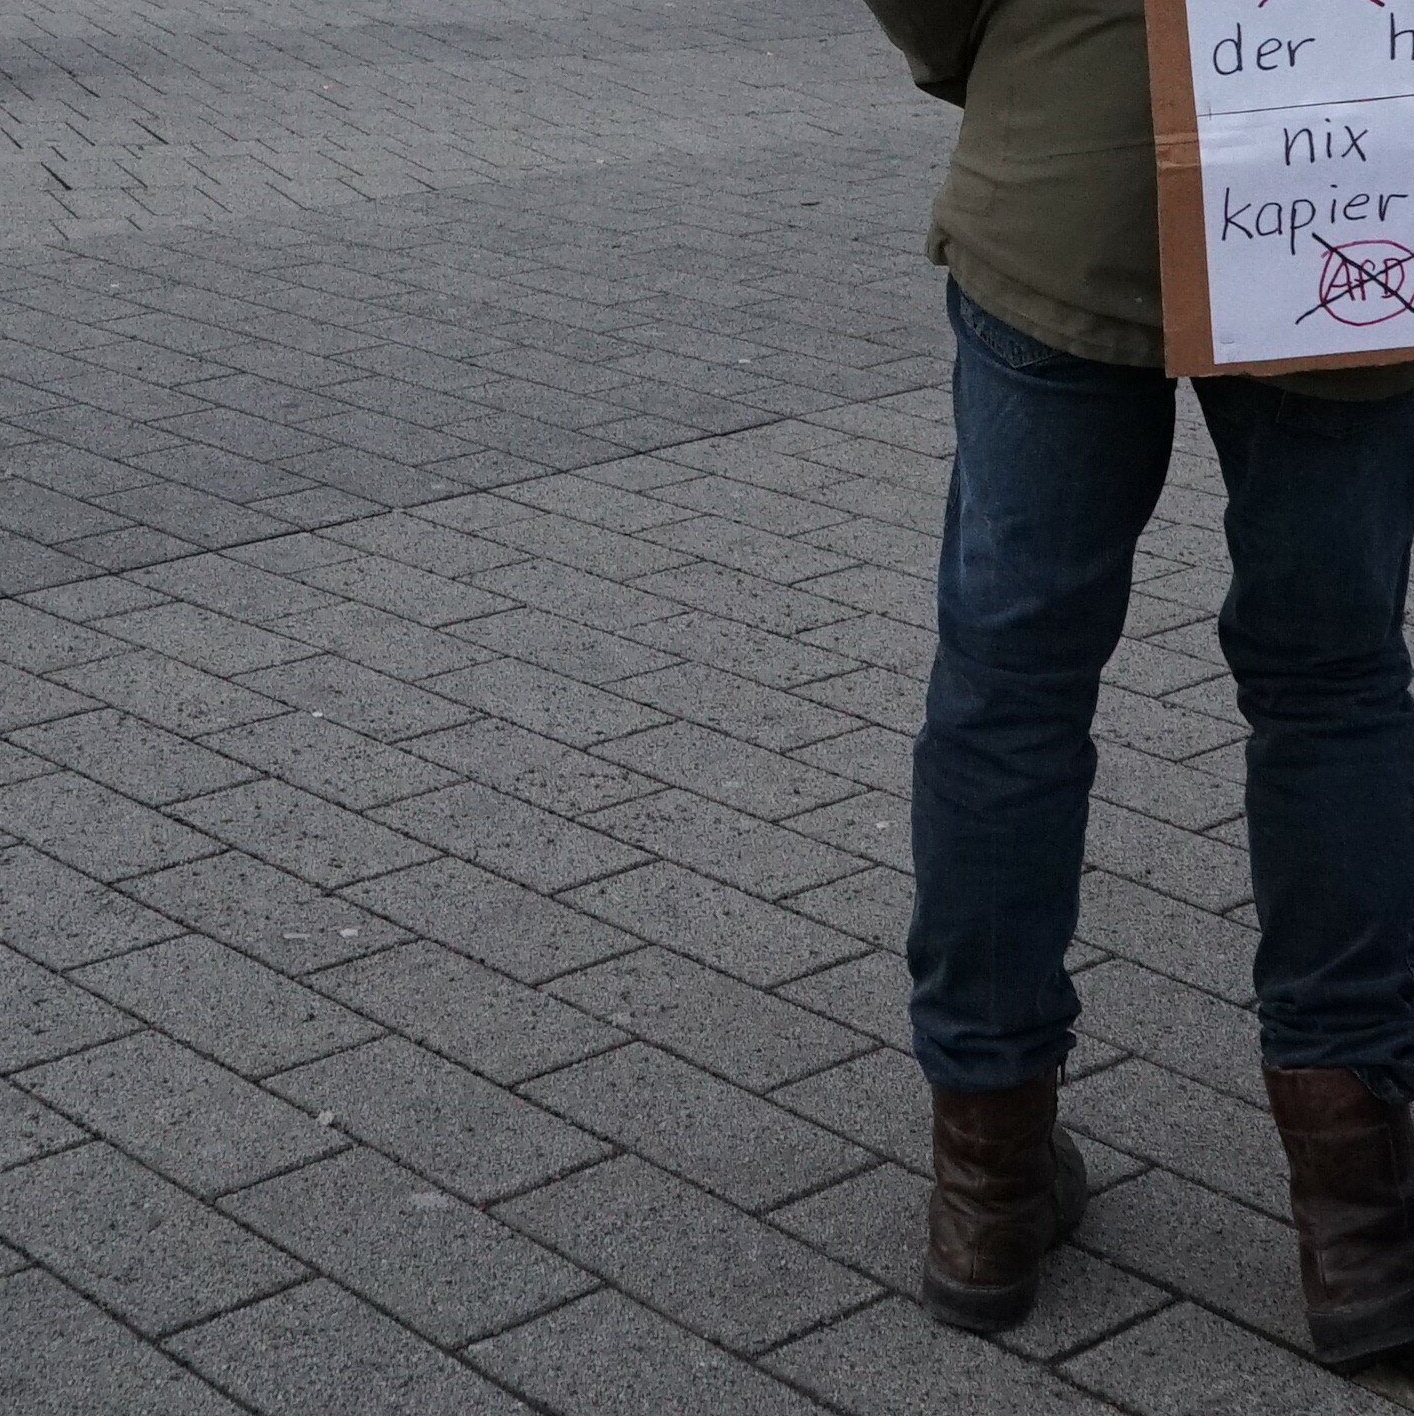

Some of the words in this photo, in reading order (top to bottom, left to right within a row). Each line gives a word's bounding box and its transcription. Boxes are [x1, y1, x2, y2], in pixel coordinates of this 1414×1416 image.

[1211, 22, 1316, 77] der
[1281, 118, 1369, 166] nix
[1322, 256, 1409, 302] AfD
